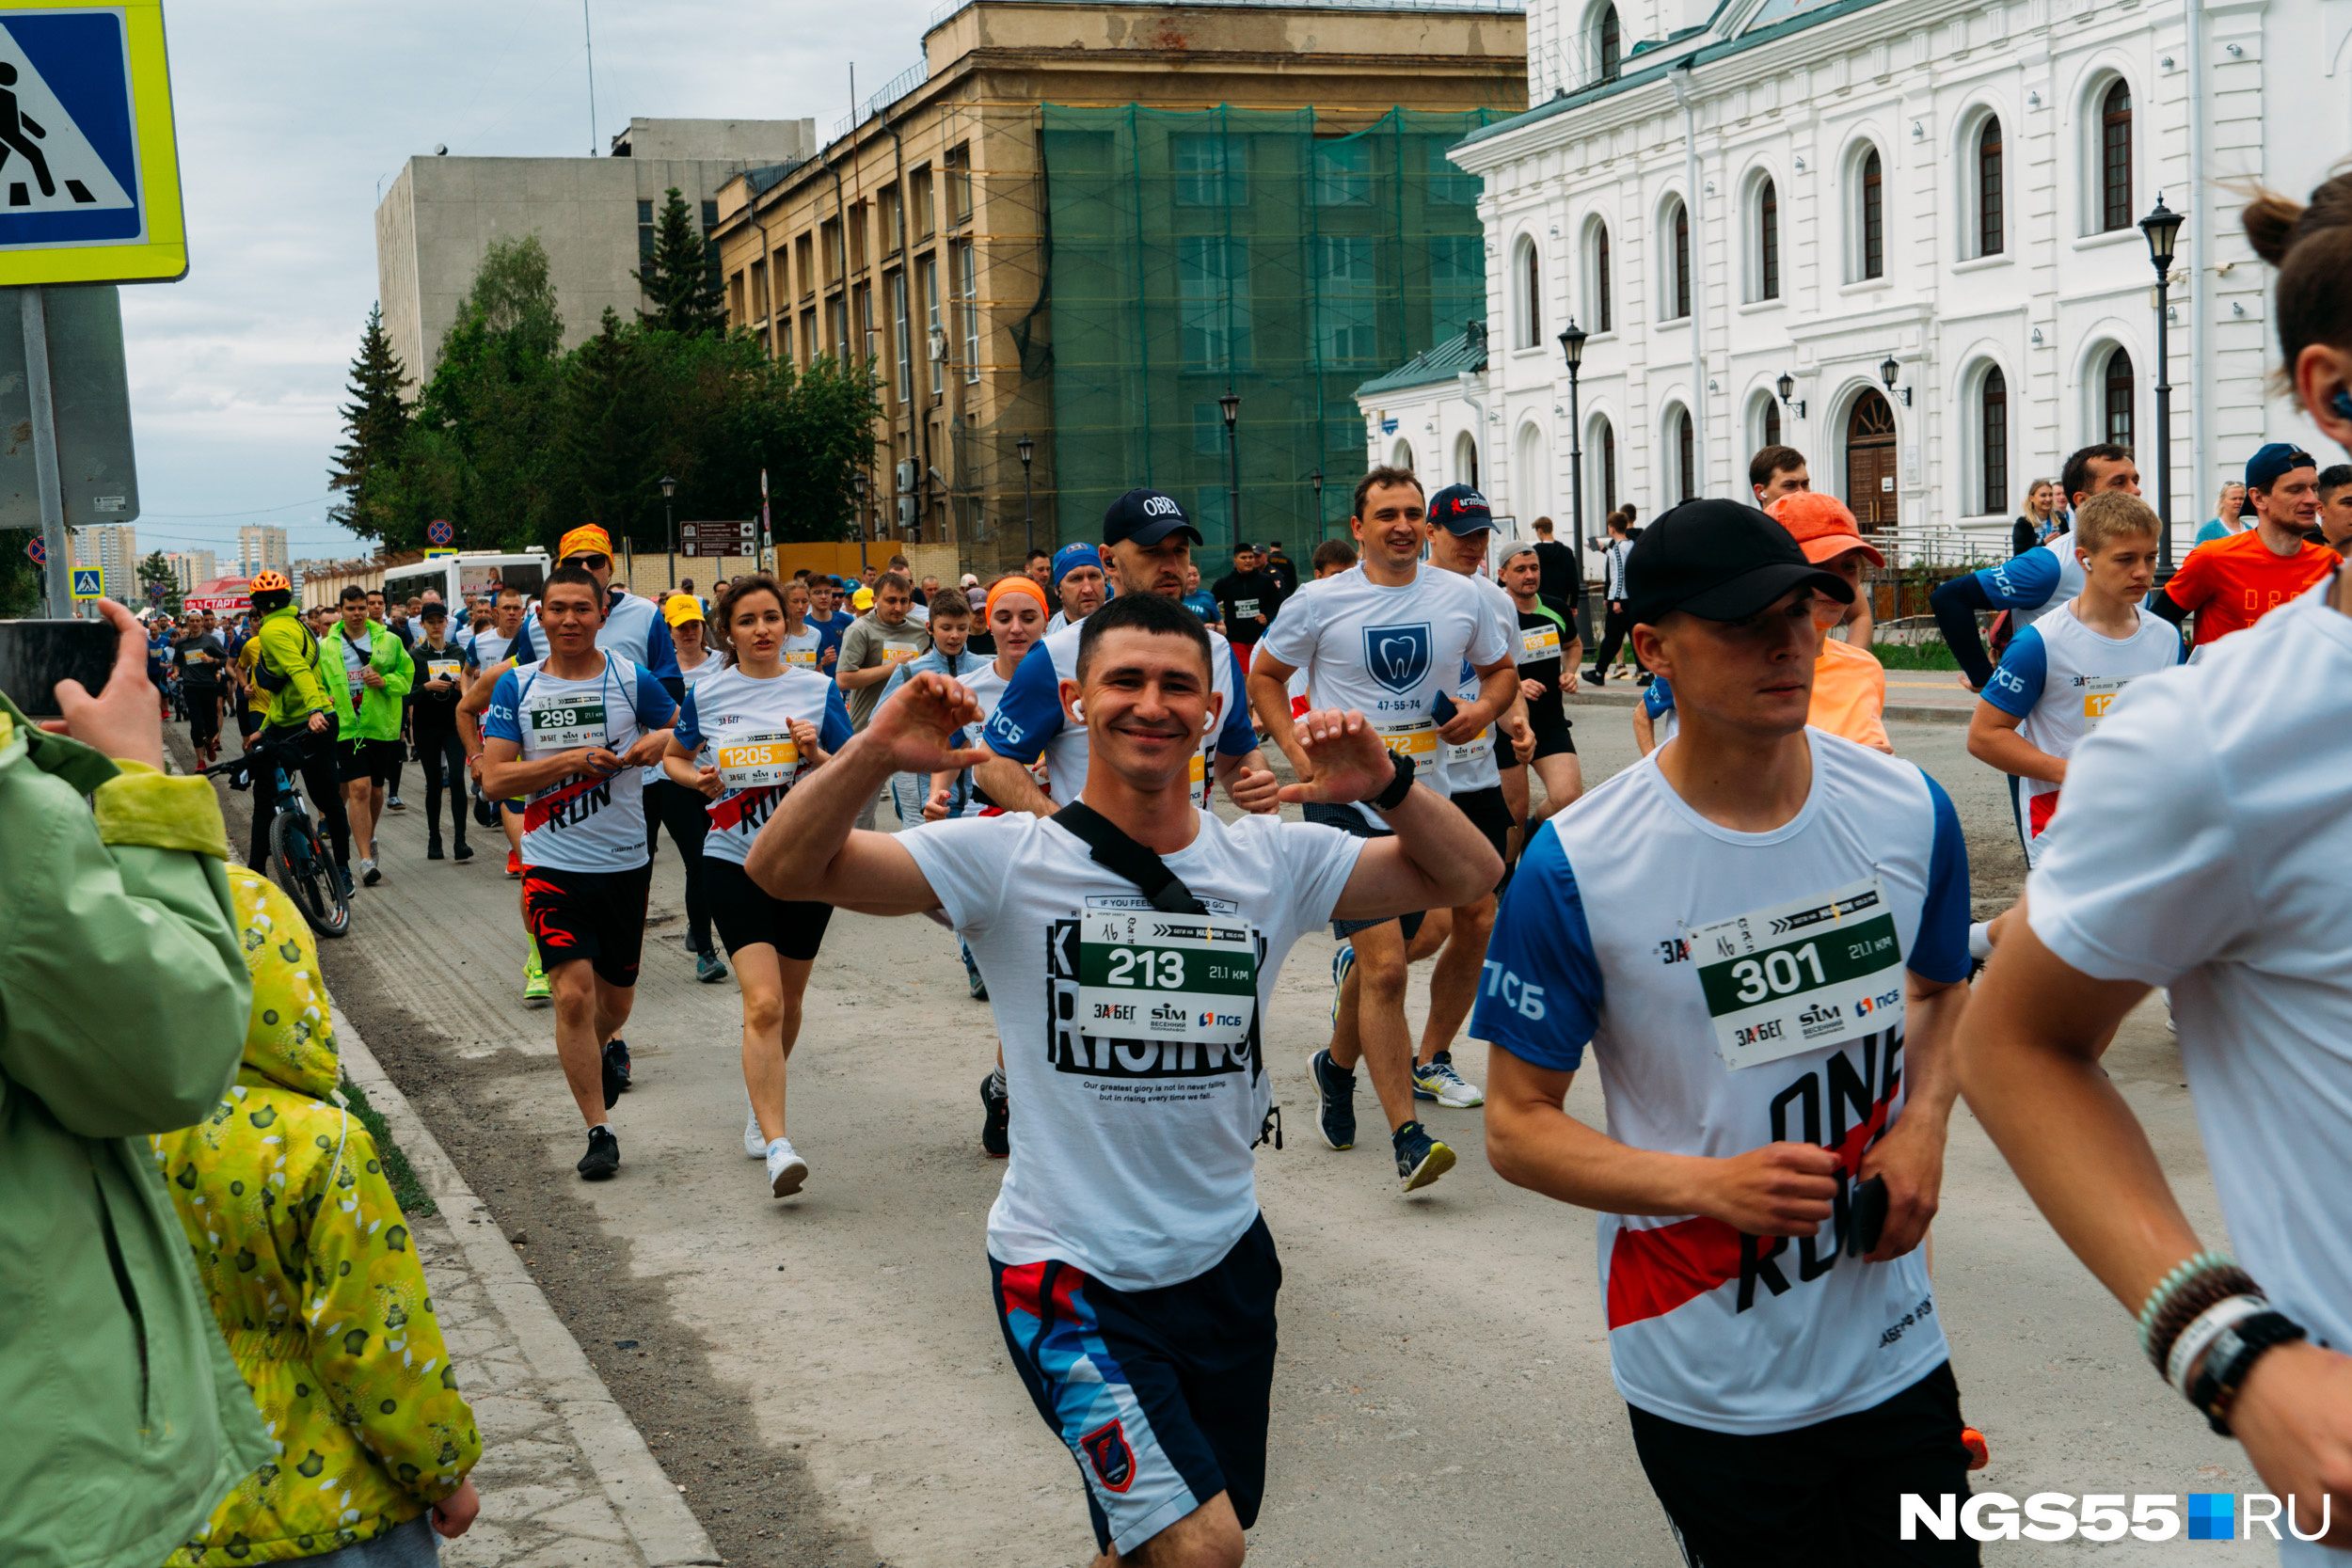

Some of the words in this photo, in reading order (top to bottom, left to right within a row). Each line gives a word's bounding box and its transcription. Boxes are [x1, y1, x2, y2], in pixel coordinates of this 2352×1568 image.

[204, 598, 237, 609] СТАРТ
[1377, 700, 1421, 711] 47-55-74
[2092, 696, 2115, 715] 12
[540, 709, 577, 727] 299
[991, 706, 1025, 744] ПСБ
[724, 747, 772, 766] 1205
[548, 778, 612, 833] RUN
[1107, 947, 1185, 989] 213
[1209, 965, 1229, 979] 21.1
[1731, 942, 1826, 1004] 301
[1848, 941, 1873, 959] 21.1
[1875, 990, 1900, 1009] ПСБ
[1216, 1015, 1242, 1026] ПСБ
[1100, 1084, 1132, 1092] greatest
[1134, 1084, 1153, 1093] glory
[1124, 1094, 1146, 1103] rising
